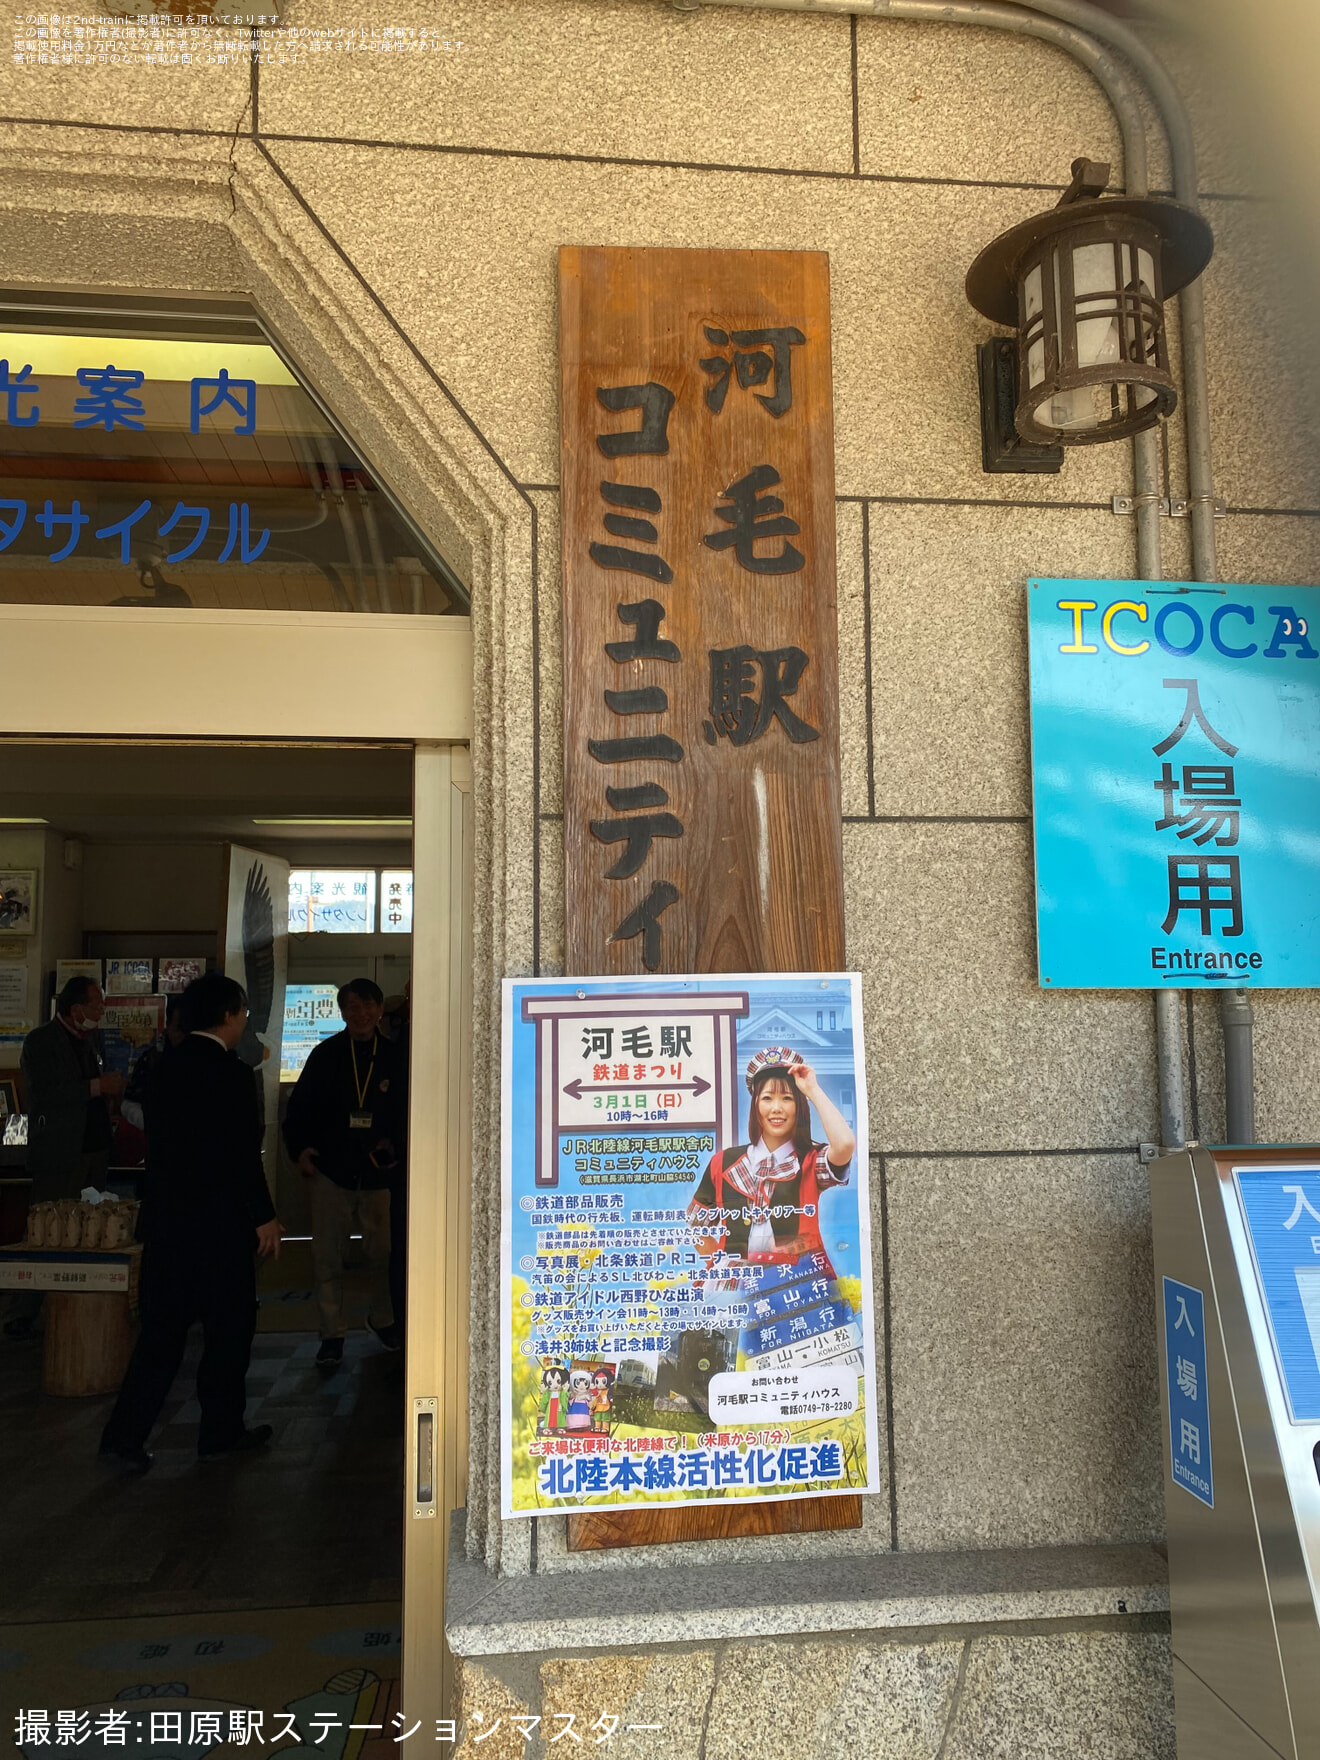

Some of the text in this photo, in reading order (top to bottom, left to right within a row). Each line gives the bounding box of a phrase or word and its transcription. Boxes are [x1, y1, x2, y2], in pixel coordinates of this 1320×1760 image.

[700, 325, 820, 746] 河毛駅
[1057, 599, 1319, 659] ICOCA
[1152, 678, 1244, 936] 入場用
[1151, 947, 1263, 971] Entrance
[581, 1025, 693, 1060] 河毛駅
[593, 1062, 682, 1081] 鉄道まつり
[593, 1093, 682, 1109] 3月1日（日）
[607, 1110, 668, 1122] 10時～16時
[563, 1136, 713, 1154] JR北陸線河毛駅駅舎内
[575, 1154, 699, 1171] コミュニティハウス
[531, 1266, 763, 1285] 汽笛の会によるSL北びわこ・北条鉄道写真展
[788, 1263, 830, 1281] KANAZAWA
[758, 1292, 829, 1320] FOR TOYAMA
[761, 1338, 782, 1351] FOR
[818, 1341, 851, 1357] KOMATSU
[752, 1376, 798, 1387] お問い合わせ
[1174, 1295, 1200, 1465] 入場用
[717, 1388, 840, 1406] 河毛駅コミュニティハウス
[780, 1401, 852, 1415] 電話0749-78-2280
[541, 1443, 841, 1494] 北陸本線活性化促進
[1174, 1458, 1210, 1494] Entrance
